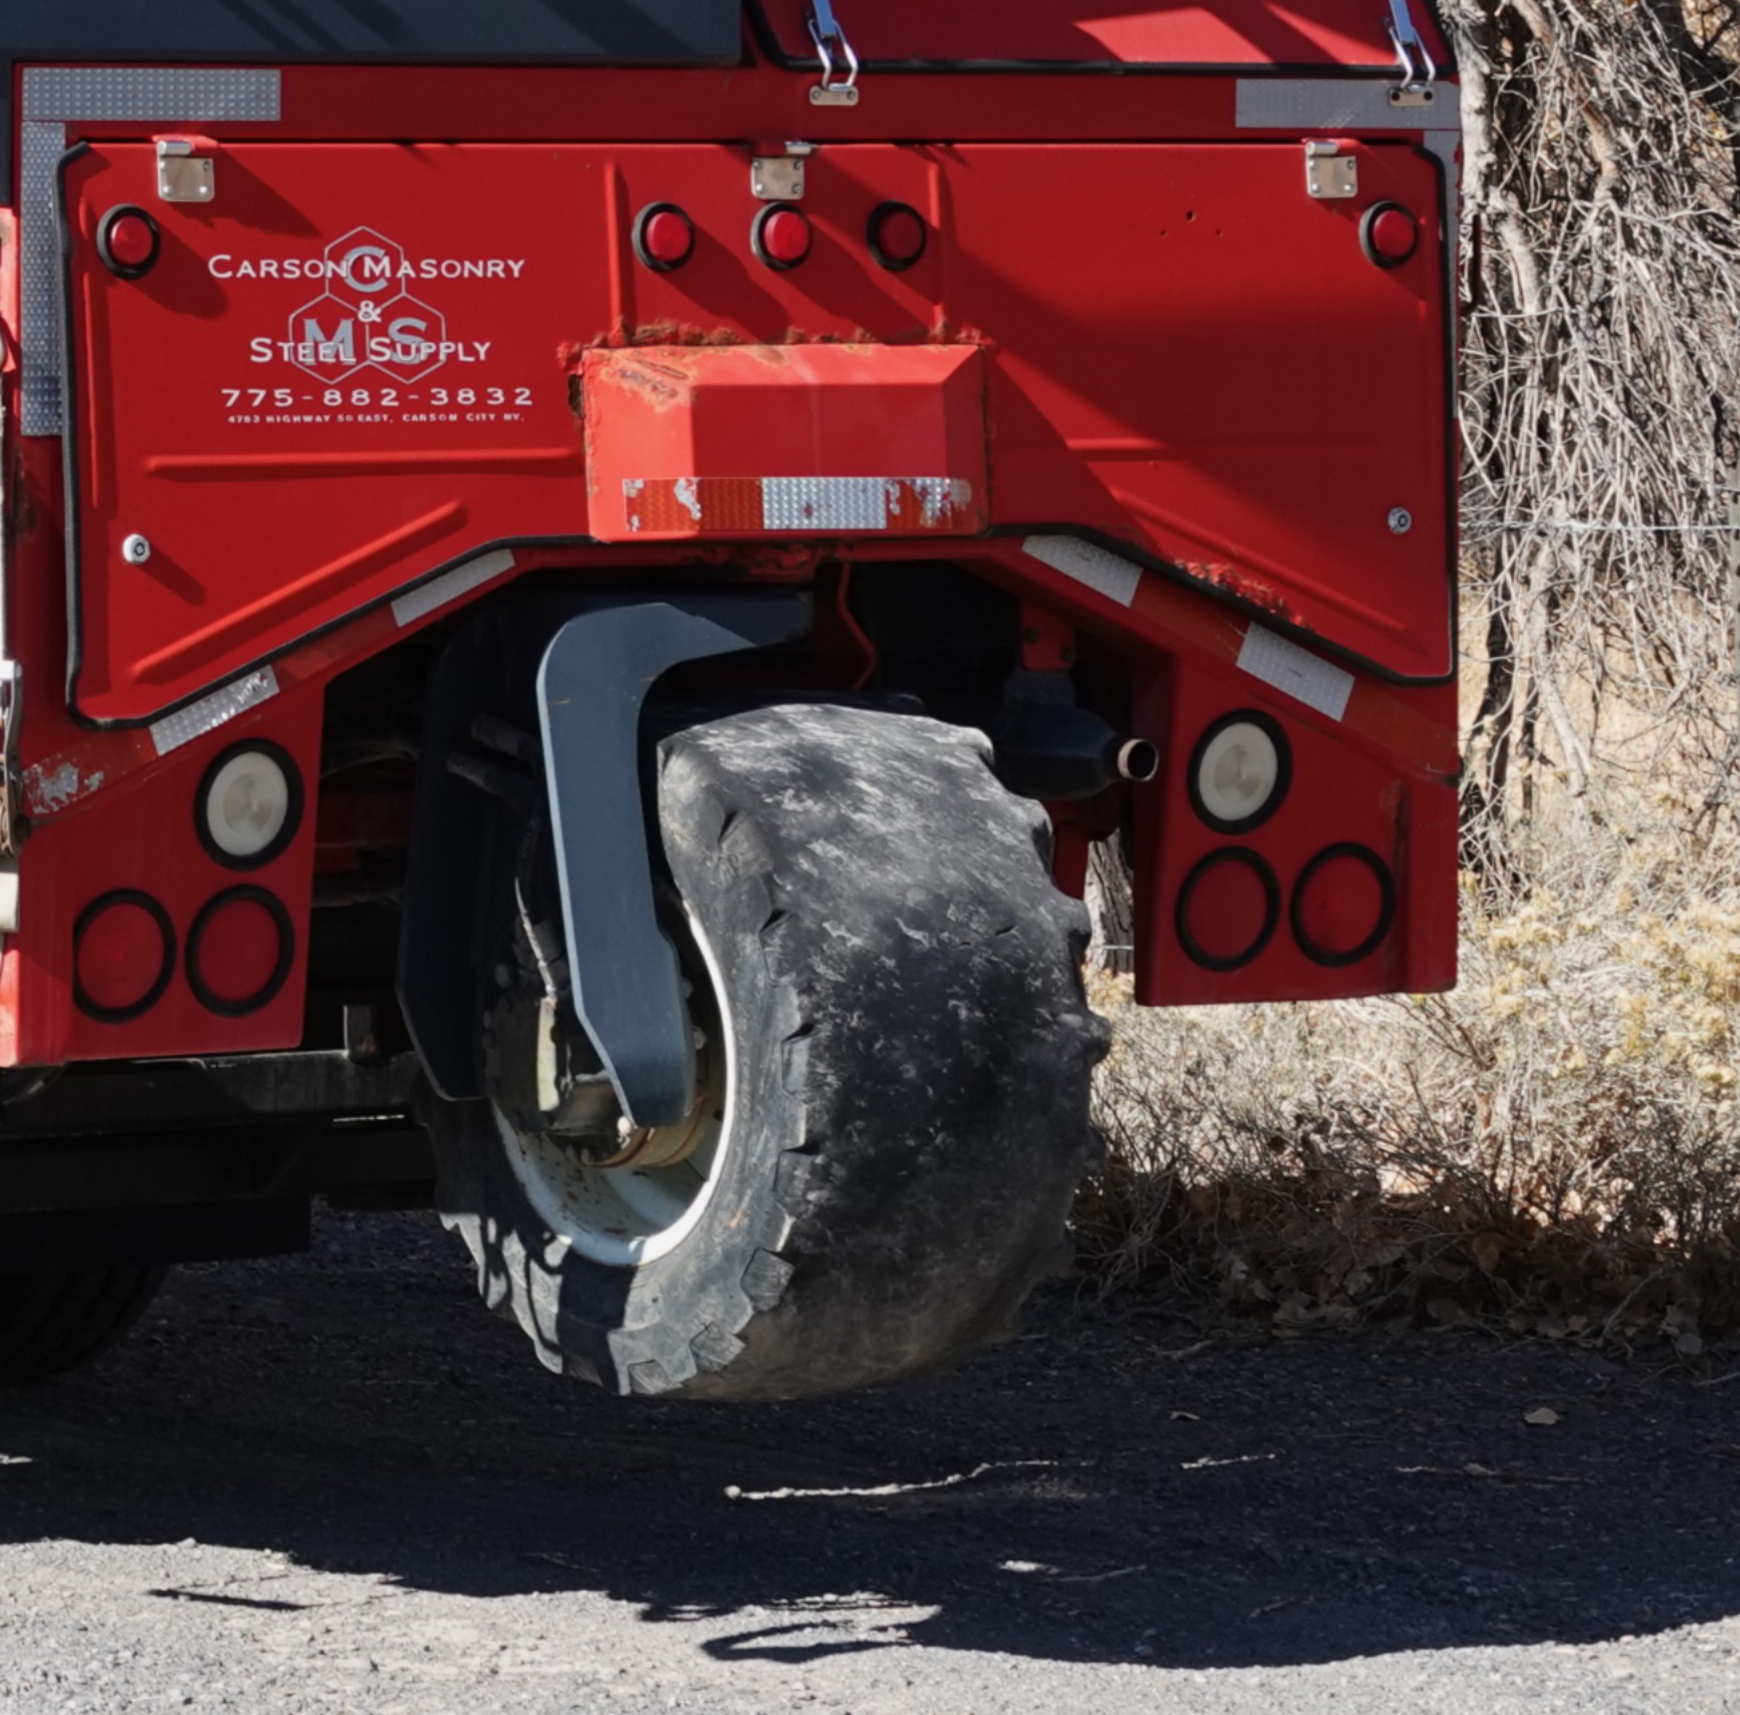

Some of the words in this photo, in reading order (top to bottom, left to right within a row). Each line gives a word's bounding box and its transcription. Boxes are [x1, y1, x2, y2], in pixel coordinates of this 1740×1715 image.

[208, 254, 349, 279] CARSON
[362, 255, 525, 279] MASONRY
[357, 300, 382, 323] &
[250, 338, 356, 364] STEEL
[369, 337, 491, 363] SUPPLY
[221, 388, 533, 407] 775-882-3832
[265, 414, 330, 423] HIGHWAY
[402, 413, 458, 423] CARSON
[466, 412, 496, 422] CITY
